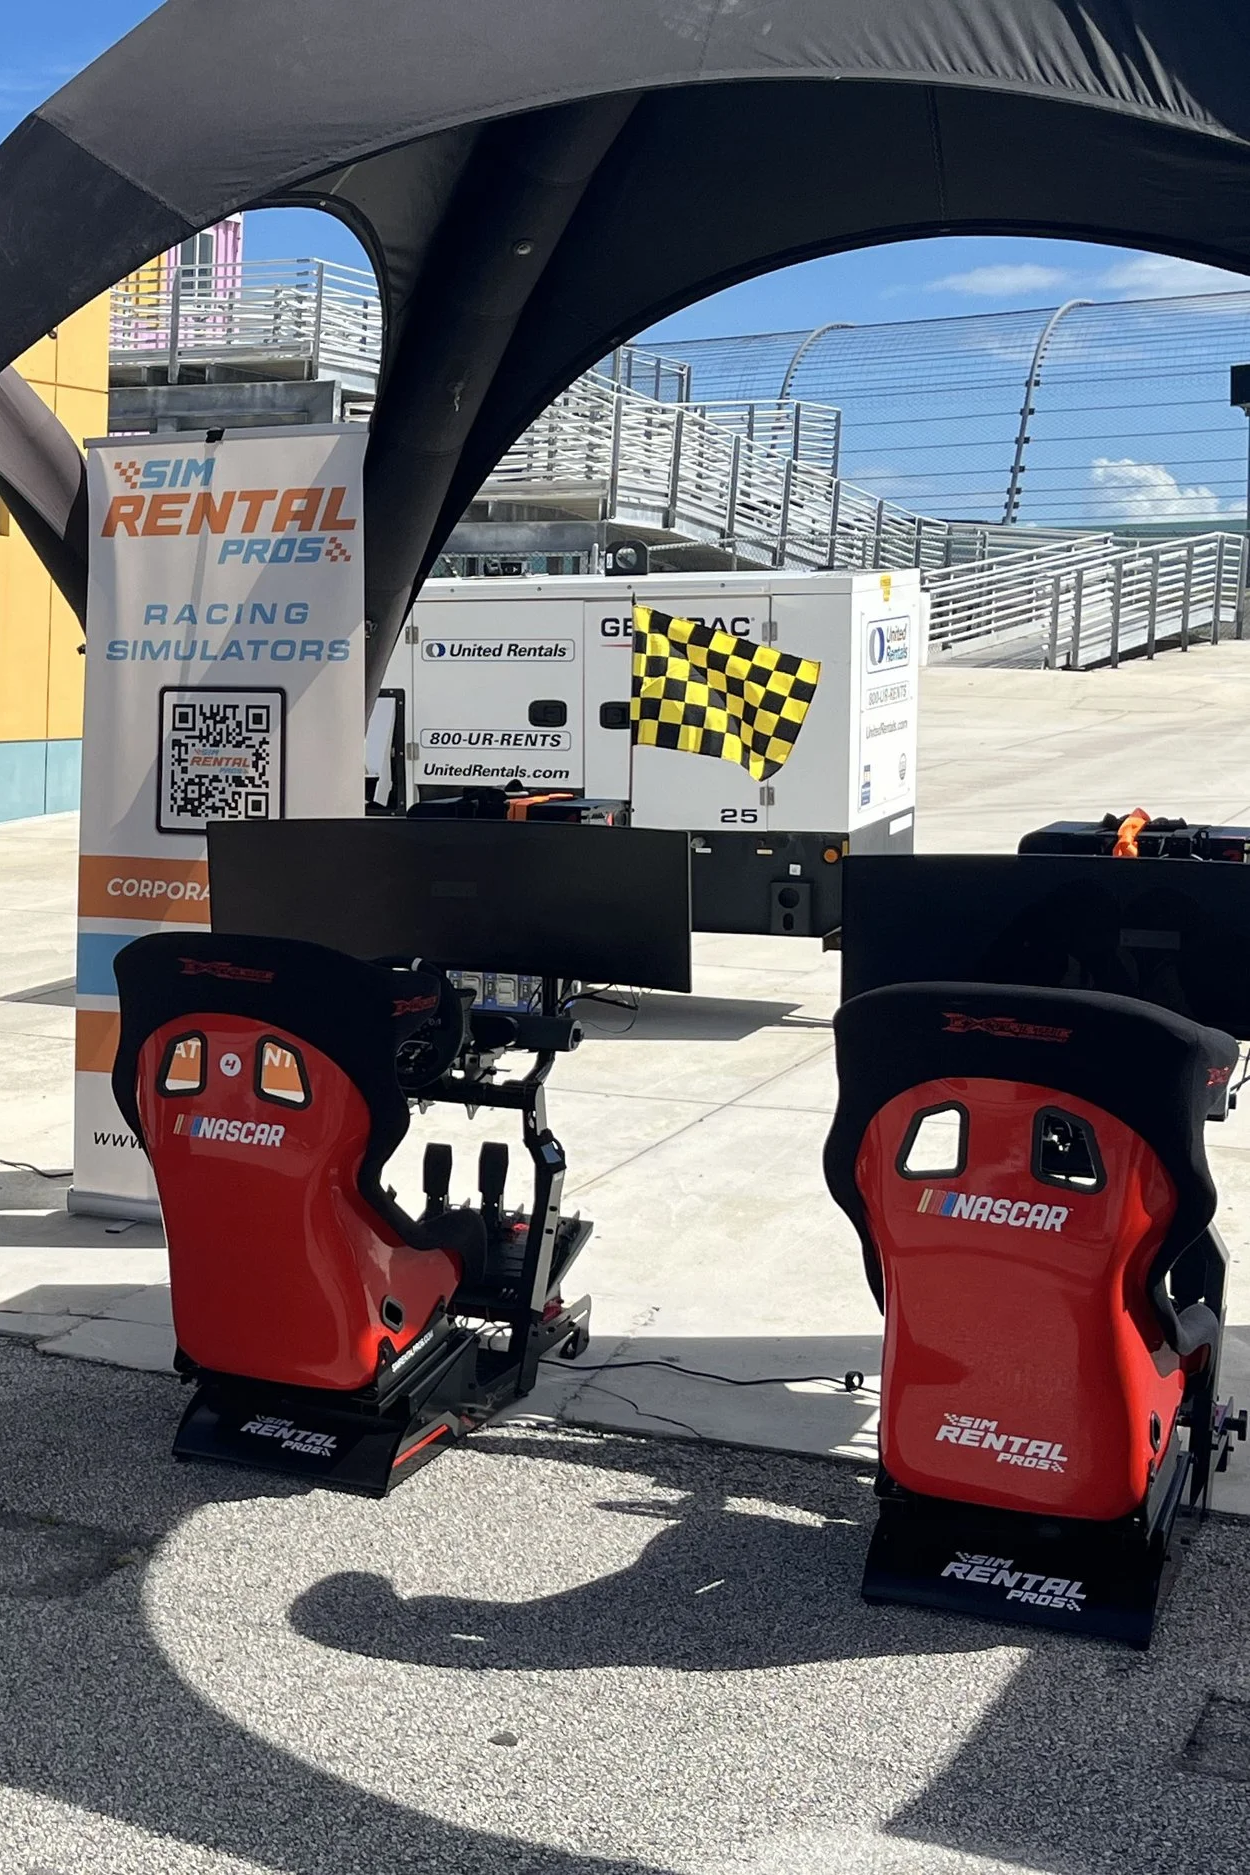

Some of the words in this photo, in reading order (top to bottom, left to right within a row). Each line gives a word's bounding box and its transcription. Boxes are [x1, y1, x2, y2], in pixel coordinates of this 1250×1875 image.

[139, 457, 215, 489] SIM
[101, 487, 356, 537] RENTAL
[217, 537, 326, 564] PROS
[144, 603, 309, 625] RACING
[886, 623, 907, 643] United
[106, 639, 350, 661] SIMULATORS
[450, 643, 503, 657] United
[507, 643, 567, 657] Rentals
[429, 732, 562, 747] 800-UR-RENTS
[190, 756, 250, 768] RENTAL
[423, 763, 570, 779] UnitedRentals.com
[720, 809, 758, 823] 25
[199, 1116, 285, 1147] NASCAR
[952, 1193, 1069, 1232] NASCAR
[956, 1415, 998, 1431] SIM
[240, 1421, 337, 1449] RENTAL
[935, 1425, 1068, 1462] RENTAL
[281, 1440, 325, 1455] PROS
[997, 1452, 1052, 1471] PROS
[968, 1554, 1014, 1569] SIM
[941, 1561, 1087, 1600] RENTAL
[1006, 1589, 1068, 1609] PROS
